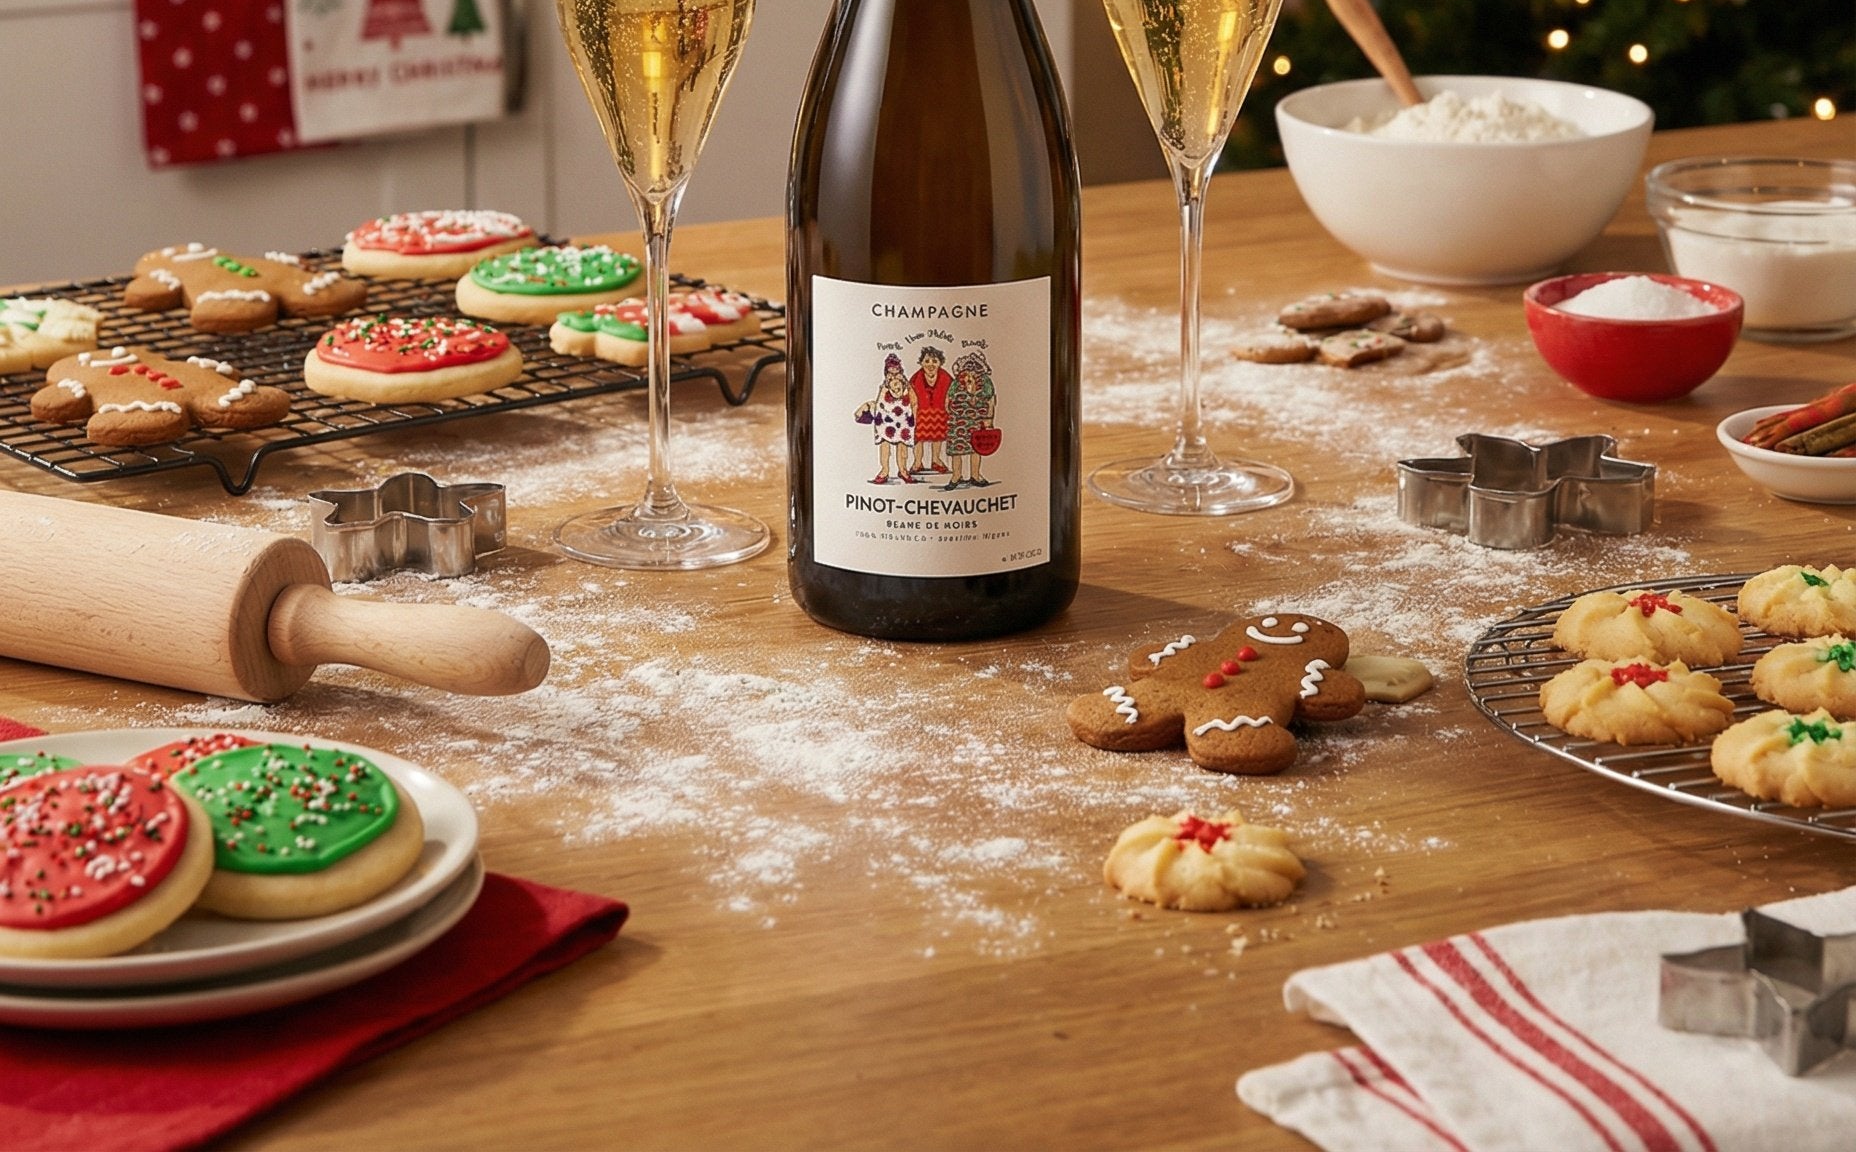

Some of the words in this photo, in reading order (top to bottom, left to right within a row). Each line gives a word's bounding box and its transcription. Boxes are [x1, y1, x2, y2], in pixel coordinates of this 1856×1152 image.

[871, 303, 989, 319] CHAMPAGNE
[846, 493, 1018, 516] PINOT-CHEVAUCHET
[926, 521, 940, 530] DE
